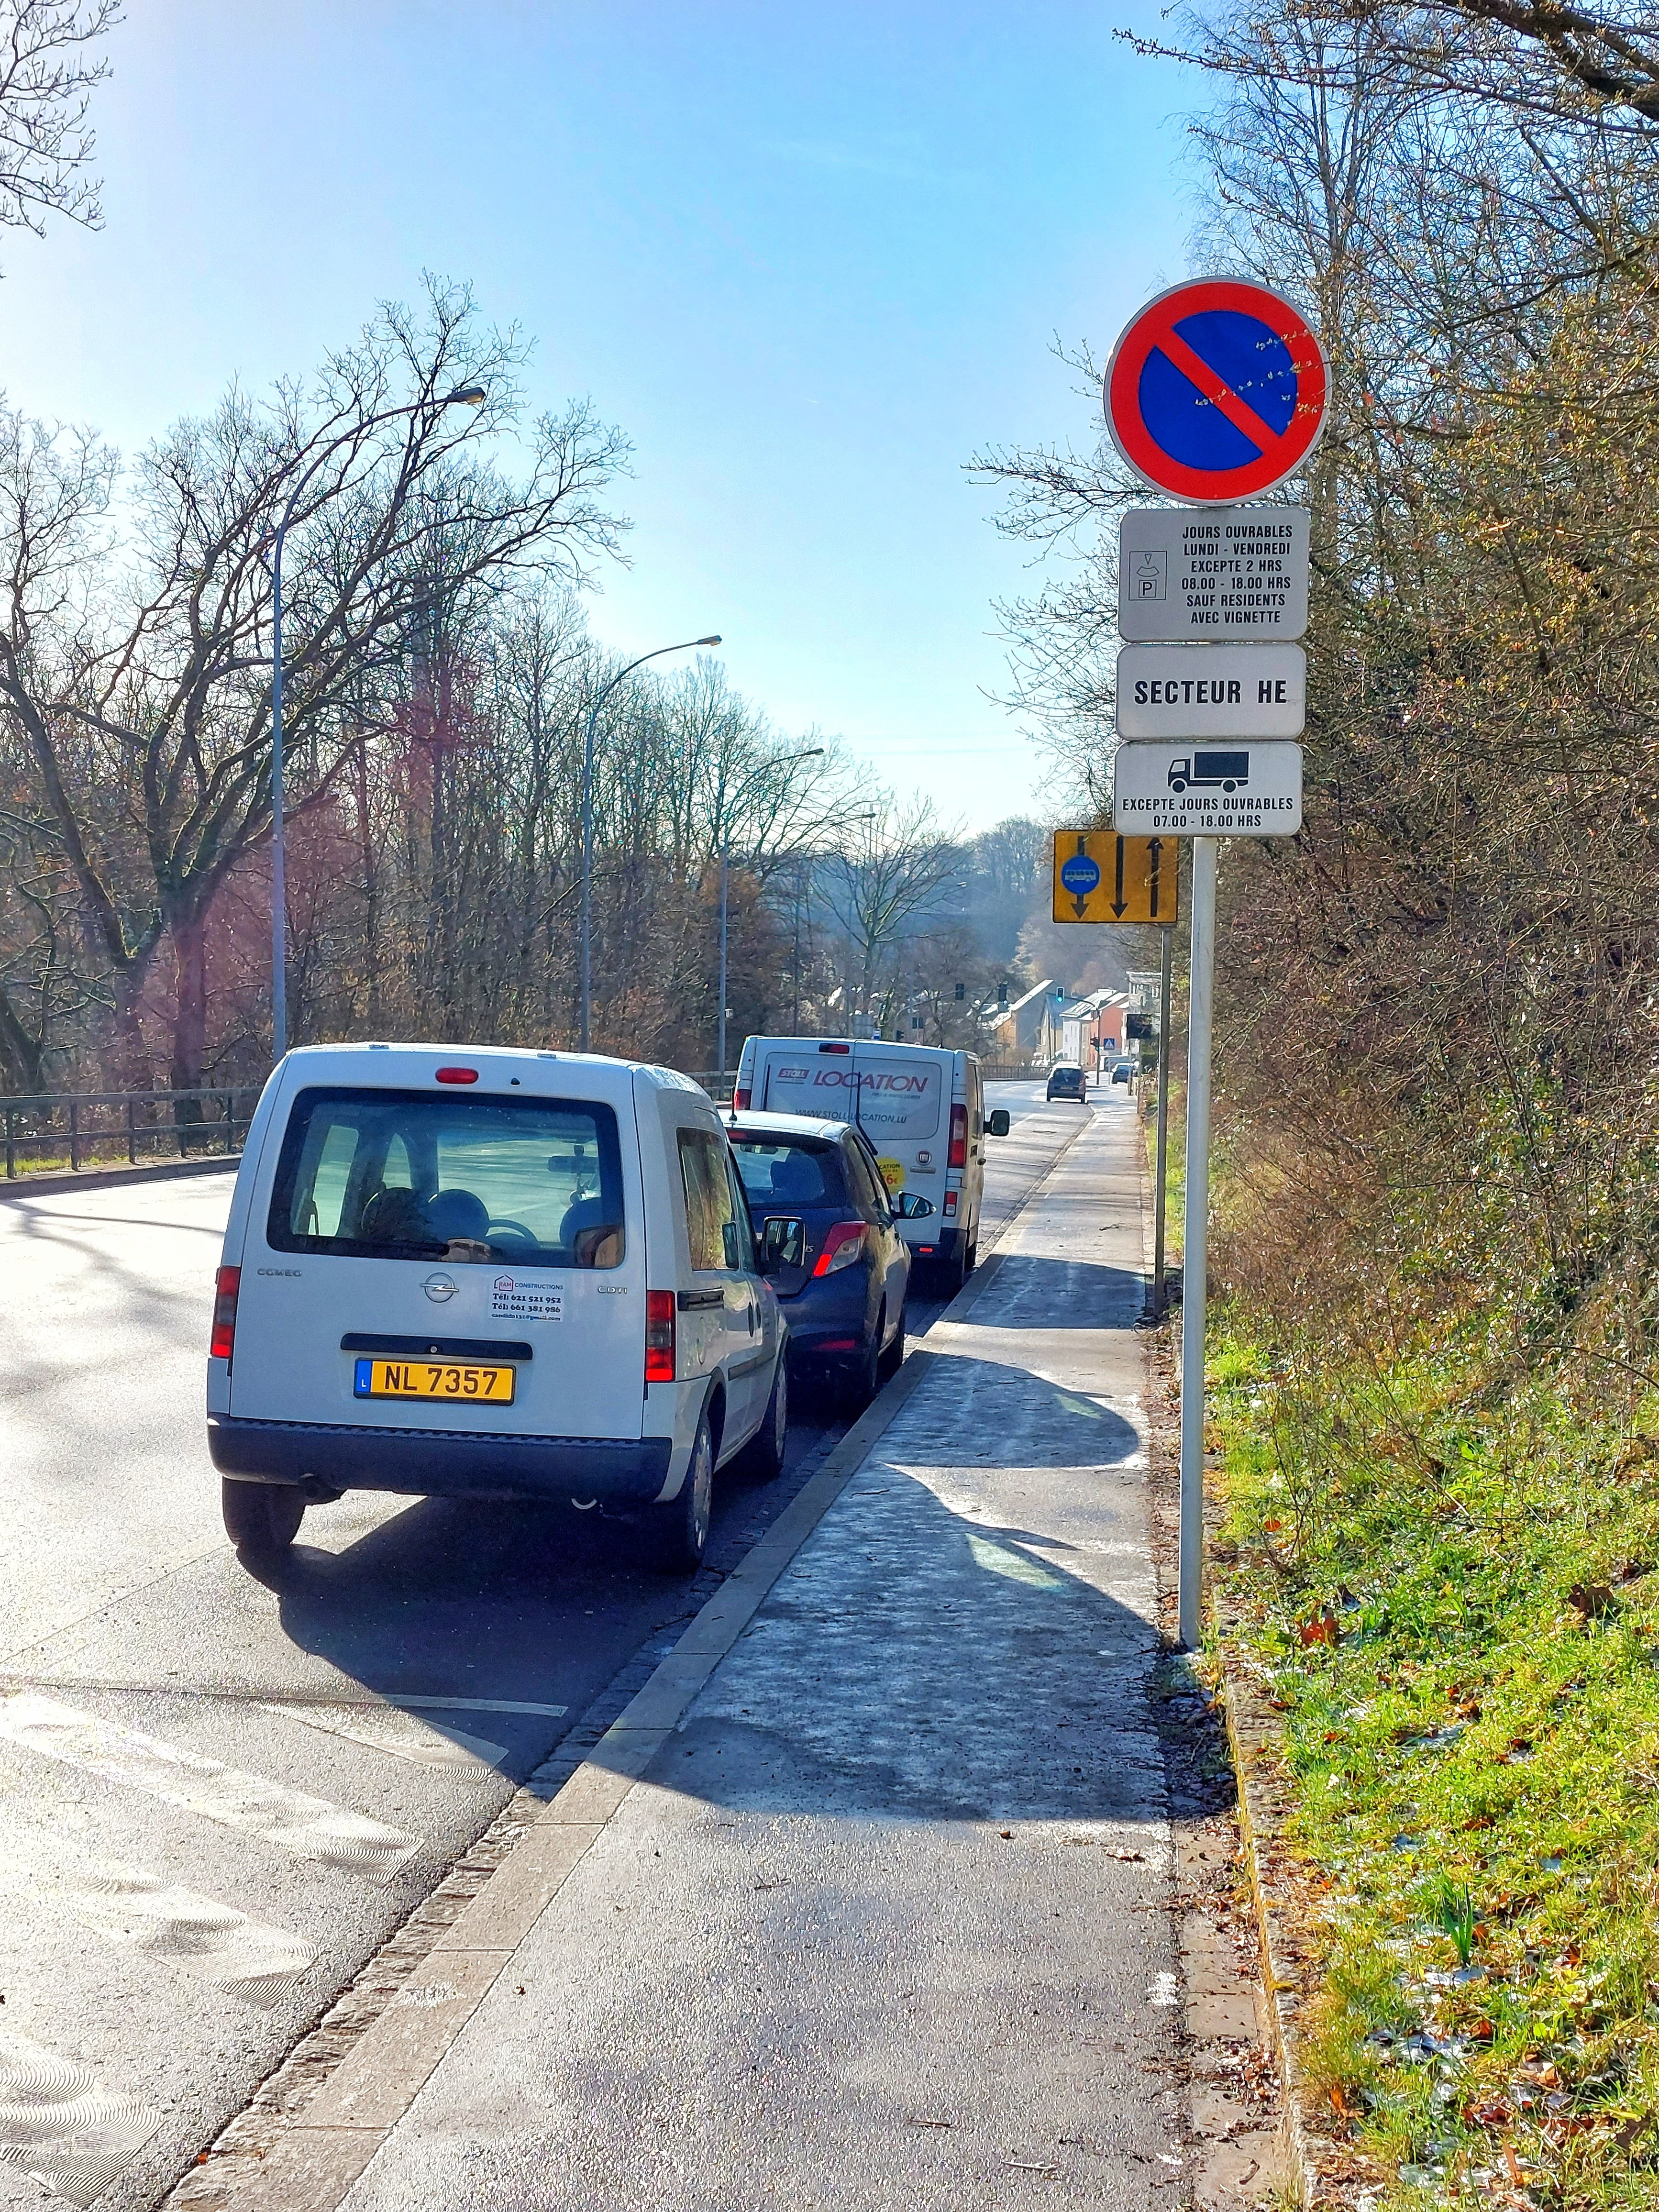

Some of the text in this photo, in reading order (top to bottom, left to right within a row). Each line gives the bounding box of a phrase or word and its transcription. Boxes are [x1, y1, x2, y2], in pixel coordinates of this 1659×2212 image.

[1182, 525, 1293, 539] JOURS OUVRABLES
[1184, 543, 1218, 556] LUNDI
[1233, 542, 1290, 555] VENDREDI
[1191, 559, 1282, 573] EXCEPTE 2 HRS
[1142, 582, 1153, 596] P
[1182, 577, 1215, 590] 08.00
[1231, 576, 1262, 589] 18.00
[1267, 576, 1291, 589] HRS
[1186, 593, 1285, 607] SAUF RESIDENTS
[1191, 611, 1281, 624] AVEC VIGNETTE
[1134, 680, 1287, 704] SECTEUR HE
[1123, 797, 1293, 811] EXCEPTE JOURS OUVRABLES
[1153, 815, 1187, 827] 07.00
[1200, 815, 1233, 827] 18.00
[1238, 815, 1261, 827] HRS
[813, 1070, 928, 1093] LOCATION
[361, 1365, 498, 1395] L NL 7357
